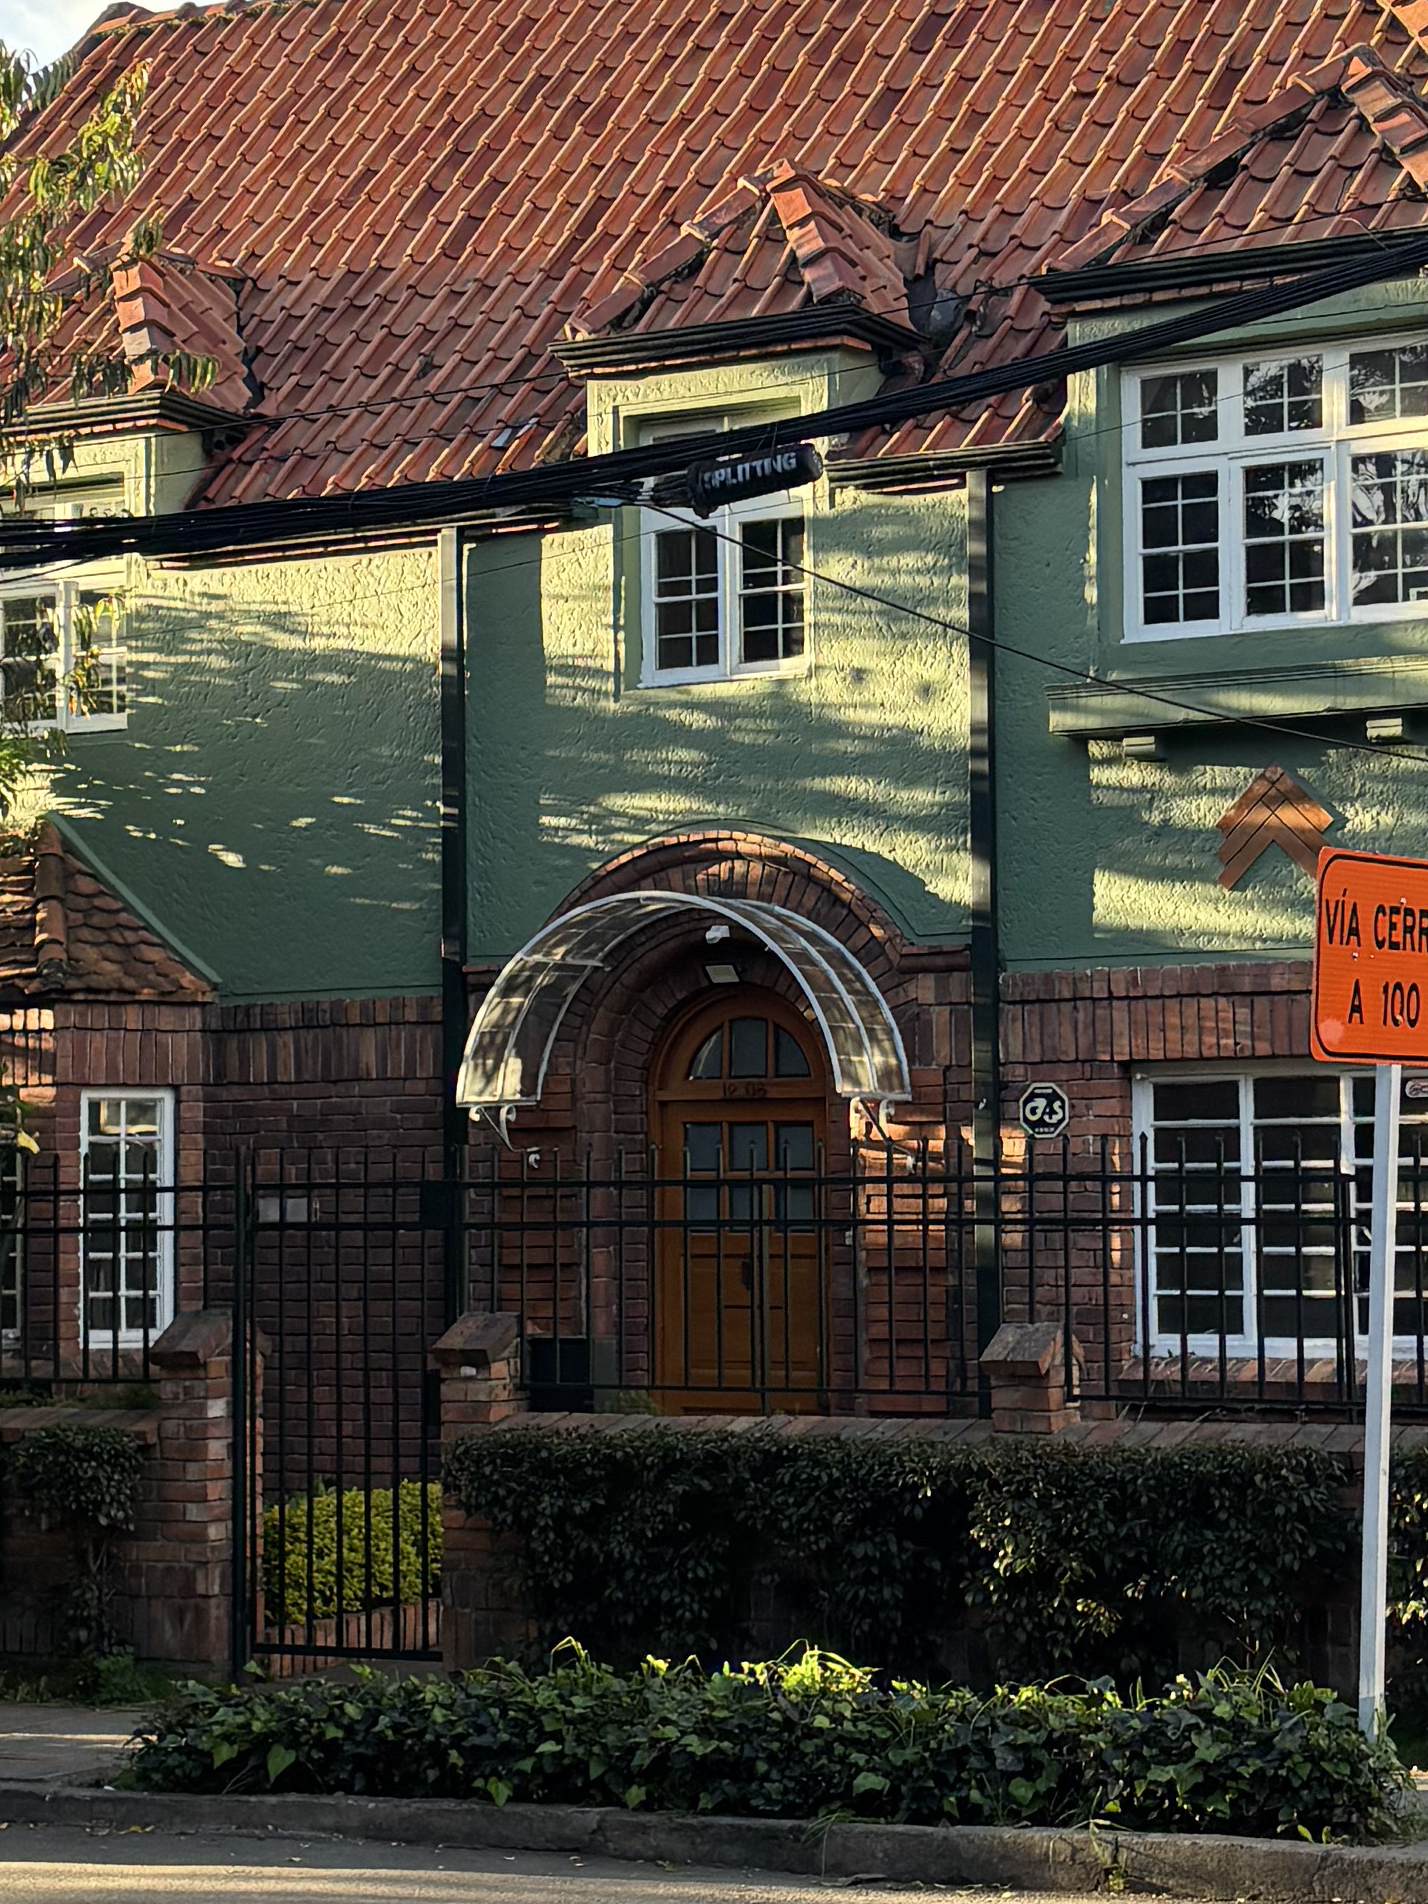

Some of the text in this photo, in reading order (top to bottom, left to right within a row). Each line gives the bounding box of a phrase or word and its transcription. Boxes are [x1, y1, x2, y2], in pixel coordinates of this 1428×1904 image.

[1325, 887, 1361, 948] VÍA
[1348, 978, 1364, 1025] A
[1382, 980, 1421, 1029] 100
